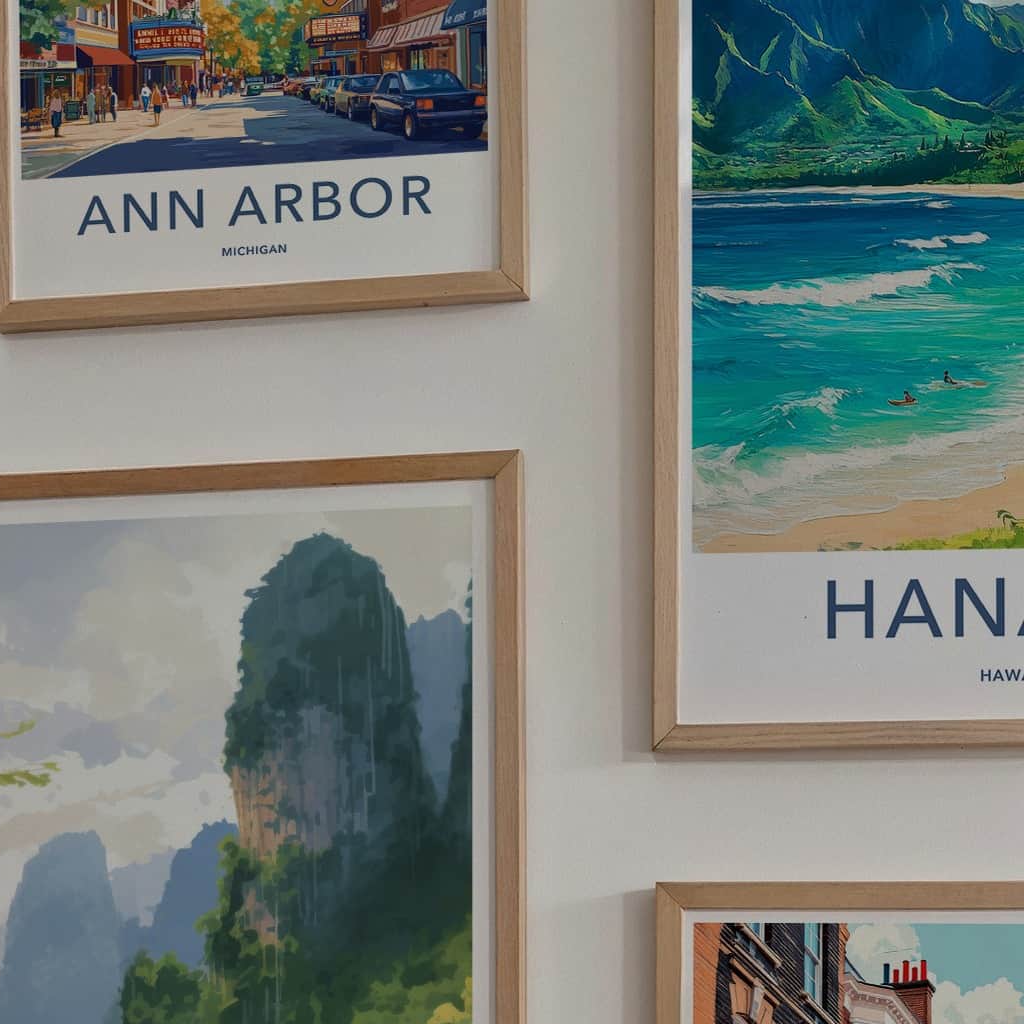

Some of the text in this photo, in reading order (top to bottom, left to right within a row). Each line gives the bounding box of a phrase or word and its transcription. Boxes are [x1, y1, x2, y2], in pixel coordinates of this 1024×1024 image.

[77, 175, 432, 236] ANN ARBOR
[221, 243, 288, 257] MICHIGAN
[827, 577, 1024, 640] HAN
[980, 668, 1024, 682] HAW
